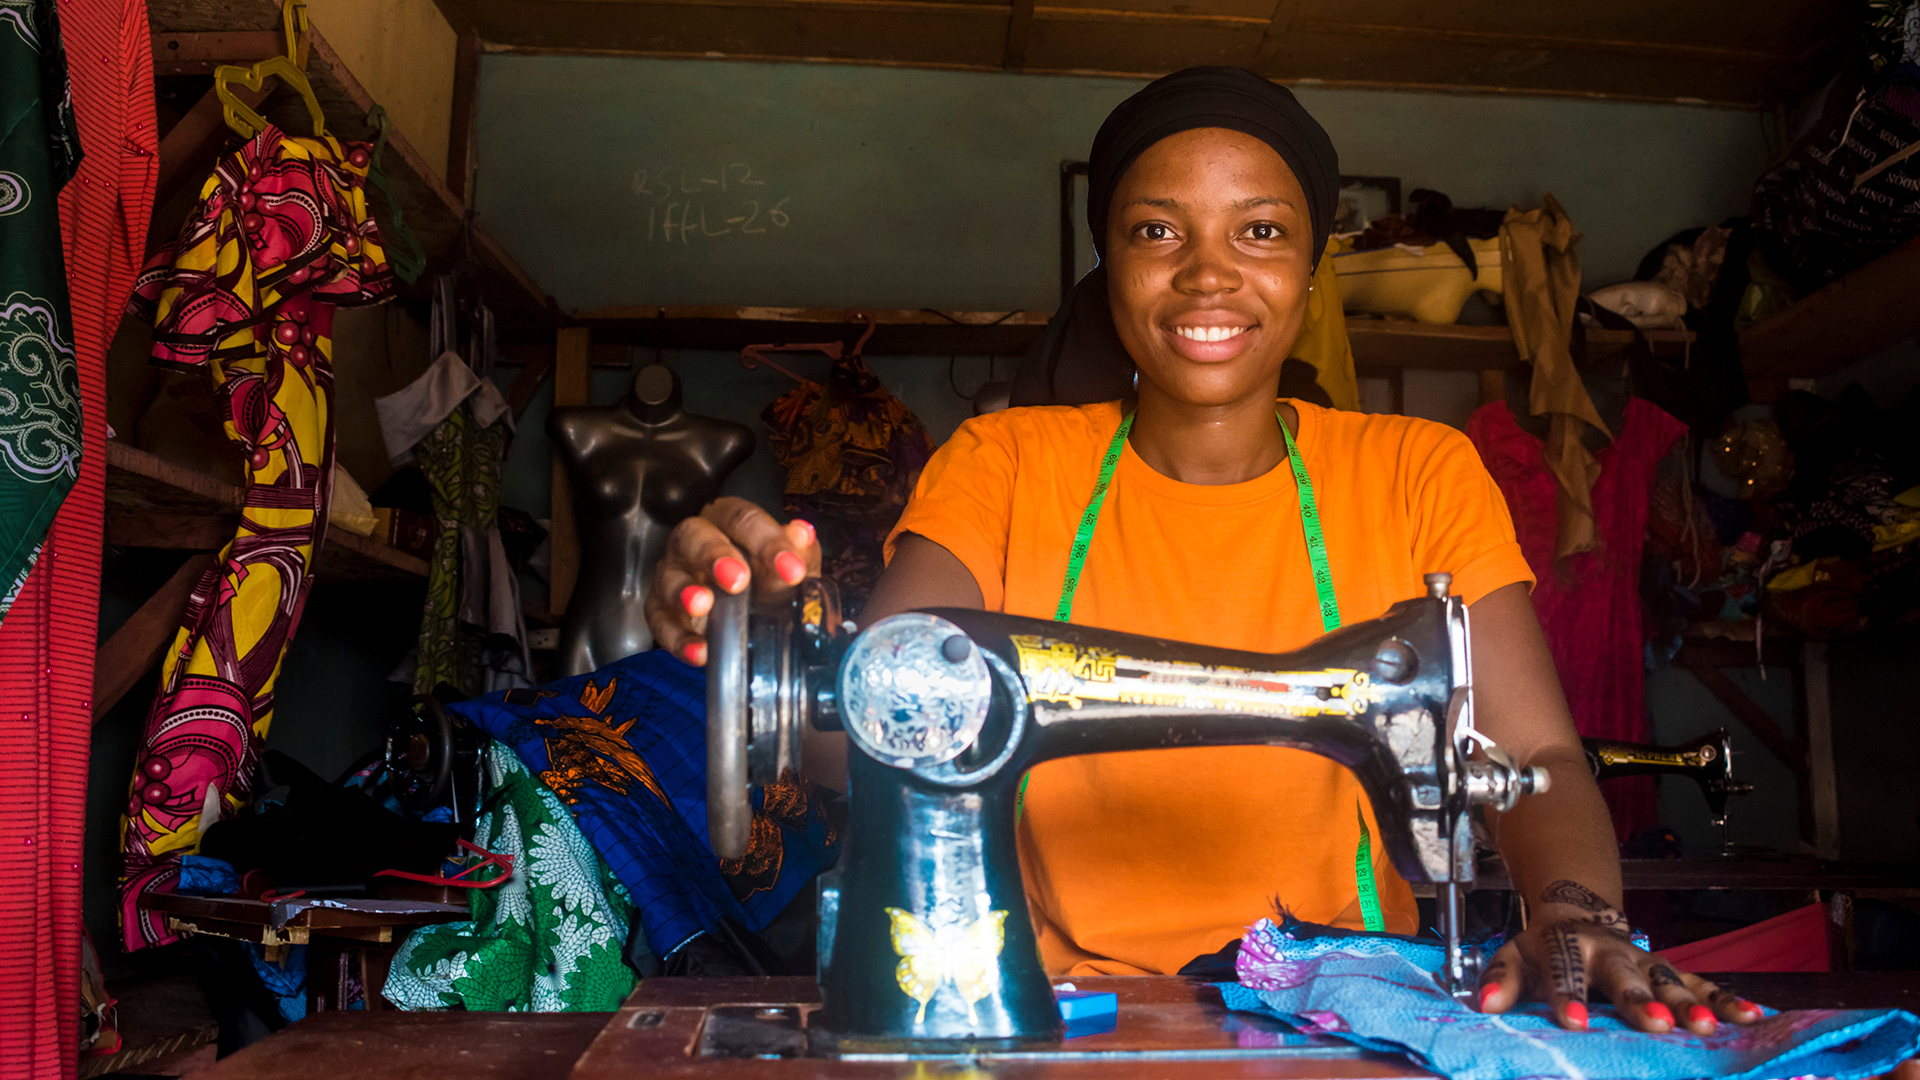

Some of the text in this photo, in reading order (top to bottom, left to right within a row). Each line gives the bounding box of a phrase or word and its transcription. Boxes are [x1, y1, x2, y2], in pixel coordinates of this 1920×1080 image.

[1066, 577, 1076, 592] 25
[1075, 544, 1086, 559] 26
[1086, 512, 1096, 526] 27
[1096, 482, 1107, 496] 28
[1107, 454, 1118, 466] 29
[1117, 426, 1128, 439] 30
[1297, 472, 1307, 485] 39
[1303, 503, 1312, 518] 40
[1309, 535, 1319, 549] 41
[1316, 569, 1326, 585] 42
[1323, 601, 1333, 617] 43
[1356, 867, 1367, 877] 129
[1358, 883, 1370, 893] 130
[1360, 900, 1372, 909] 131
[1363, 915, 1376, 925] 132
